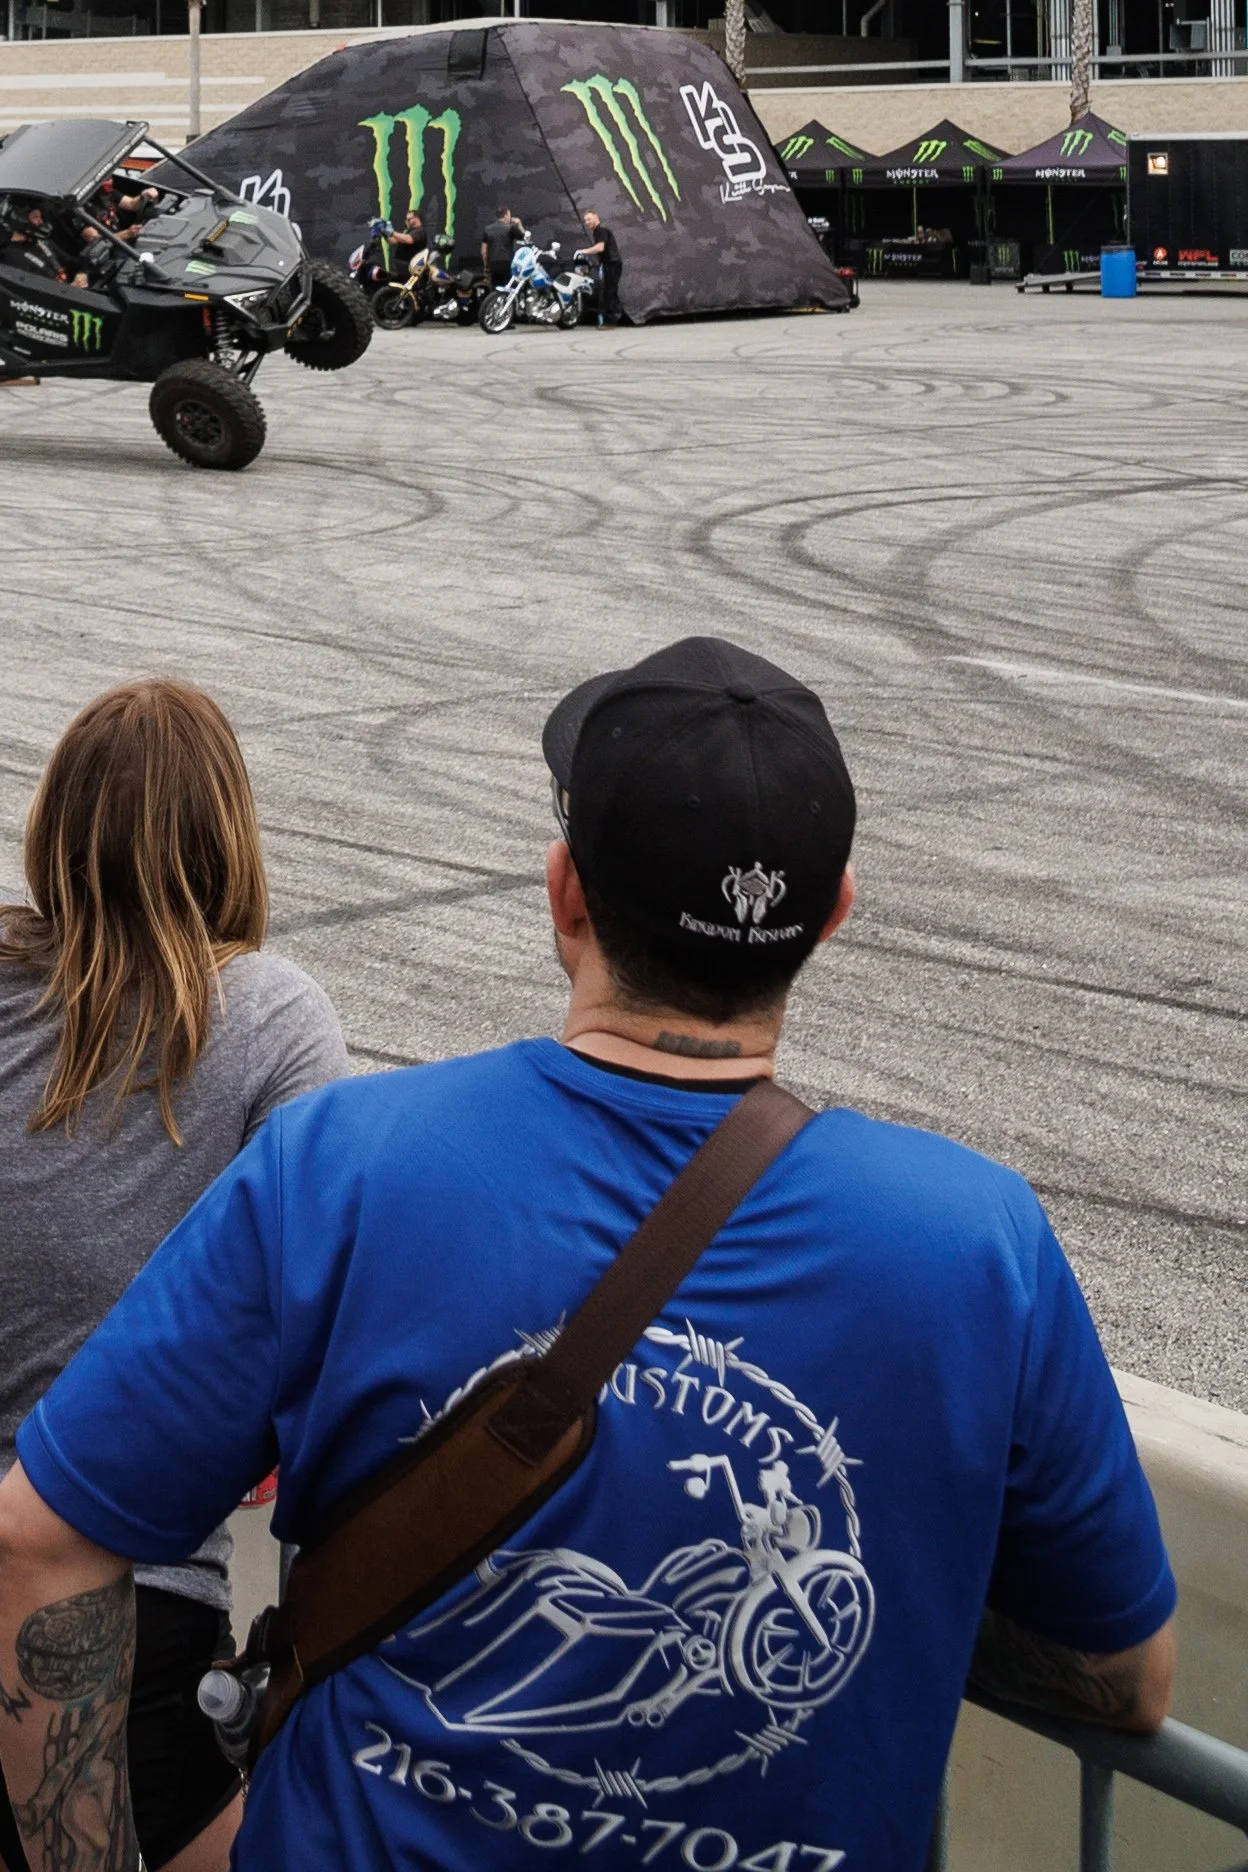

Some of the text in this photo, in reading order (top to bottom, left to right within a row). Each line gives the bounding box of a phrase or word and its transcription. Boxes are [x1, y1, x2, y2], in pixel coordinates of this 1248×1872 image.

[885, 168, 939, 179] MONSTER
[1035, 168, 1086, 179] MONSTER
[9, 299, 70, 325] MONSTER
[598, 1362, 796, 1464] USTOMS
[352, 1721, 846, 1872] 216-387-7047
